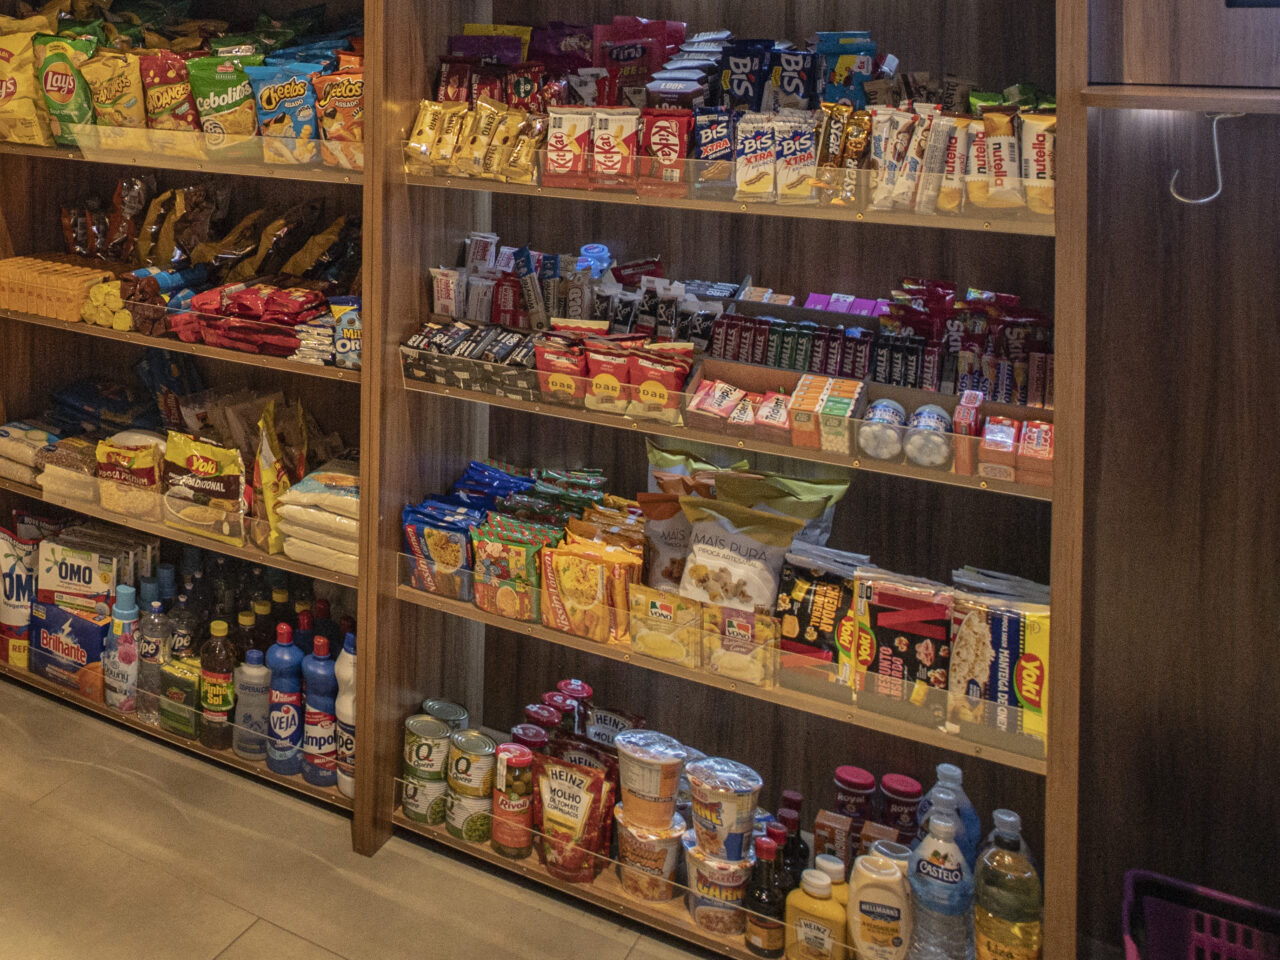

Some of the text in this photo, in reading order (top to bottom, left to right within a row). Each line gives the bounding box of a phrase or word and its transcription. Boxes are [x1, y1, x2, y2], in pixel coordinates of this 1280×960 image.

[46, 70, 75, 95] Lay's
[260, 78, 307, 111] Cheetos
[196, 81, 252, 112] Cebolitos
[549, 134, 570, 170] KitKat
[595, 136, 621, 170] KitKat
[652, 125, 678, 164] KitKat
[701, 138, 731, 159] XTRA
[972, 131, 987, 174] nutella
[1032, 133, 1047, 180] nutella
[744, 150, 774, 166] XTRA
[784, 153, 814, 168] XTRA
[945, 135, 958, 181] nutella
[992, 142, 1008, 187] nutella
[876, 348, 889, 383] HALLS
[892, 351, 903, 381] HALLS
[907, 355, 918, 383] HALLS
[923, 355, 935, 390] HALLS
[732, 397, 751, 423] Trident
[765, 397, 785, 422] Trident
[192, 455, 217, 474] Yoki
[694, 532, 768, 562] MAÏS PURA
[58, 561, 93, 585] OMO
[721, 552, 758, 569] ARTESANAL
[544, 555, 558, 592] Lámen
[650, 609, 672, 621] VONO
[819, 583, 841, 633] CHEDDAR
[40, 628, 88, 665] Brilhante
[727, 627, 751, 641] VONO
[839, 619, 854, 649] Yoki
[858, 631, 871, 663] Yoki
[202, 682, 226, 696] Pinho
[997, 648, 1010, 705] MANTEIGA DE
[1020, 660, 1041, 702] Yoki
[207, 695, 223, 706] Sol
[272, 715, 297, 730] VEJA
[595, 713, 627, 731] HEINZ
[413, 760, 435, 769] Quero
[452, 771, 472, 783] Quero
[455, 756, 471, 776] Q
[551, 769, 585, 788] HEINZ
[499, 797, 529, 810] Rivoli
[549, 787, 582, 804] MOLHO
[558, 800, 580, 812] TOMATE
[836, 792, 866, 804] Royal
[919, 860, 962, 882] CASTELO
[802, 921, 828, 935] HEINZ
